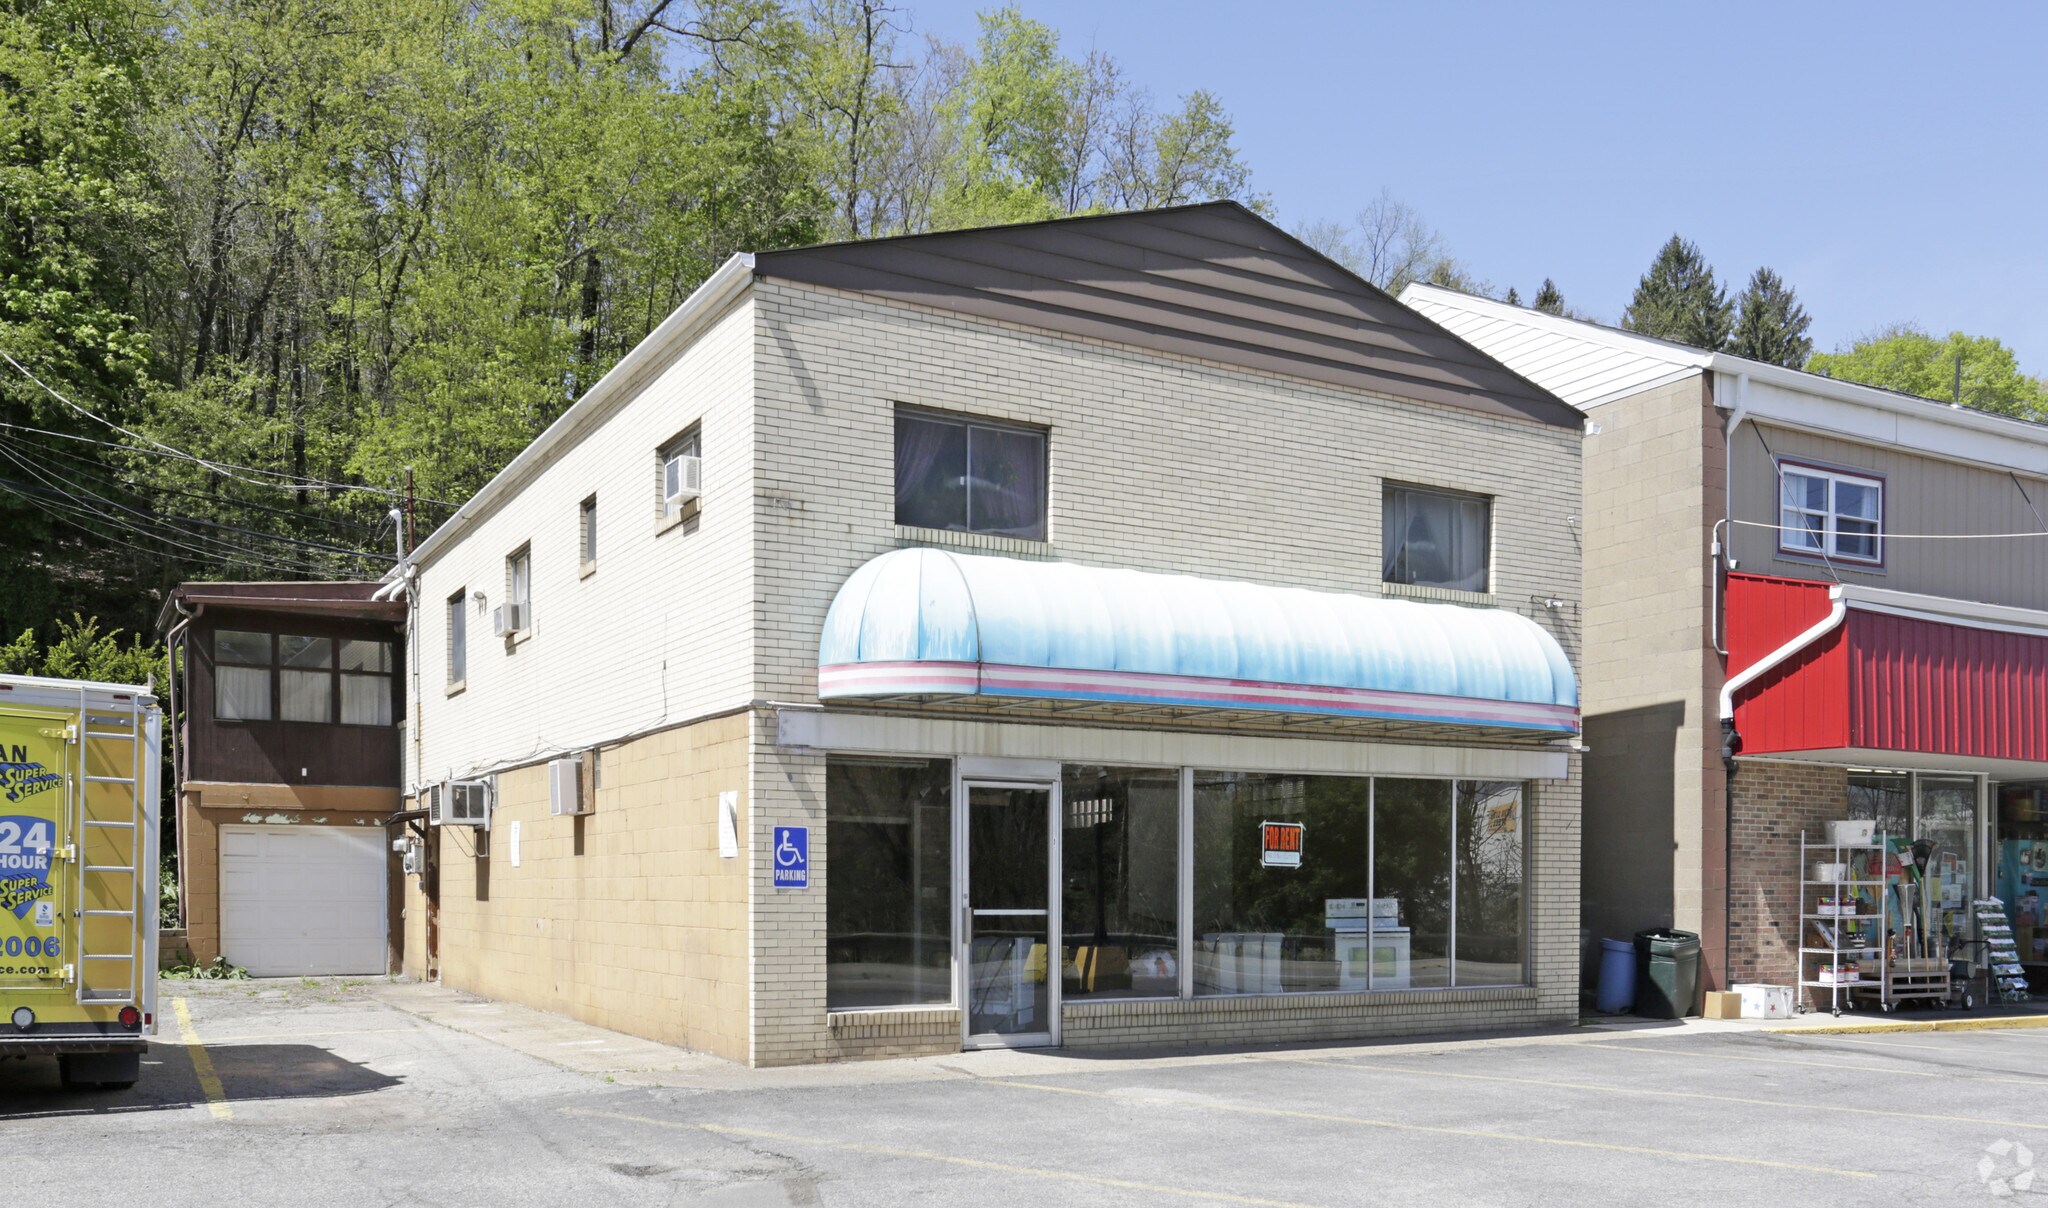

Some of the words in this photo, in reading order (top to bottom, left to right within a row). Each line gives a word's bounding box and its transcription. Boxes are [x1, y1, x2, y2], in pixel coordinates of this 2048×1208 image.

[5, 767, 47, 789] SUPER
[13, 778, 63, 803] SERVICE
[0, 821, 51, 854] 24
[1265, 825, 1279, 850] FOR
[1280, 826, 1300, 850] RENT
[0, 854, 48, 870] HOUR
[775, 869, 806, 881] PARKING
[0, 877, 38, 898] SUPER
[7, 886, 53, 911] SERVICE
[0, 935, 61, 957] 006
